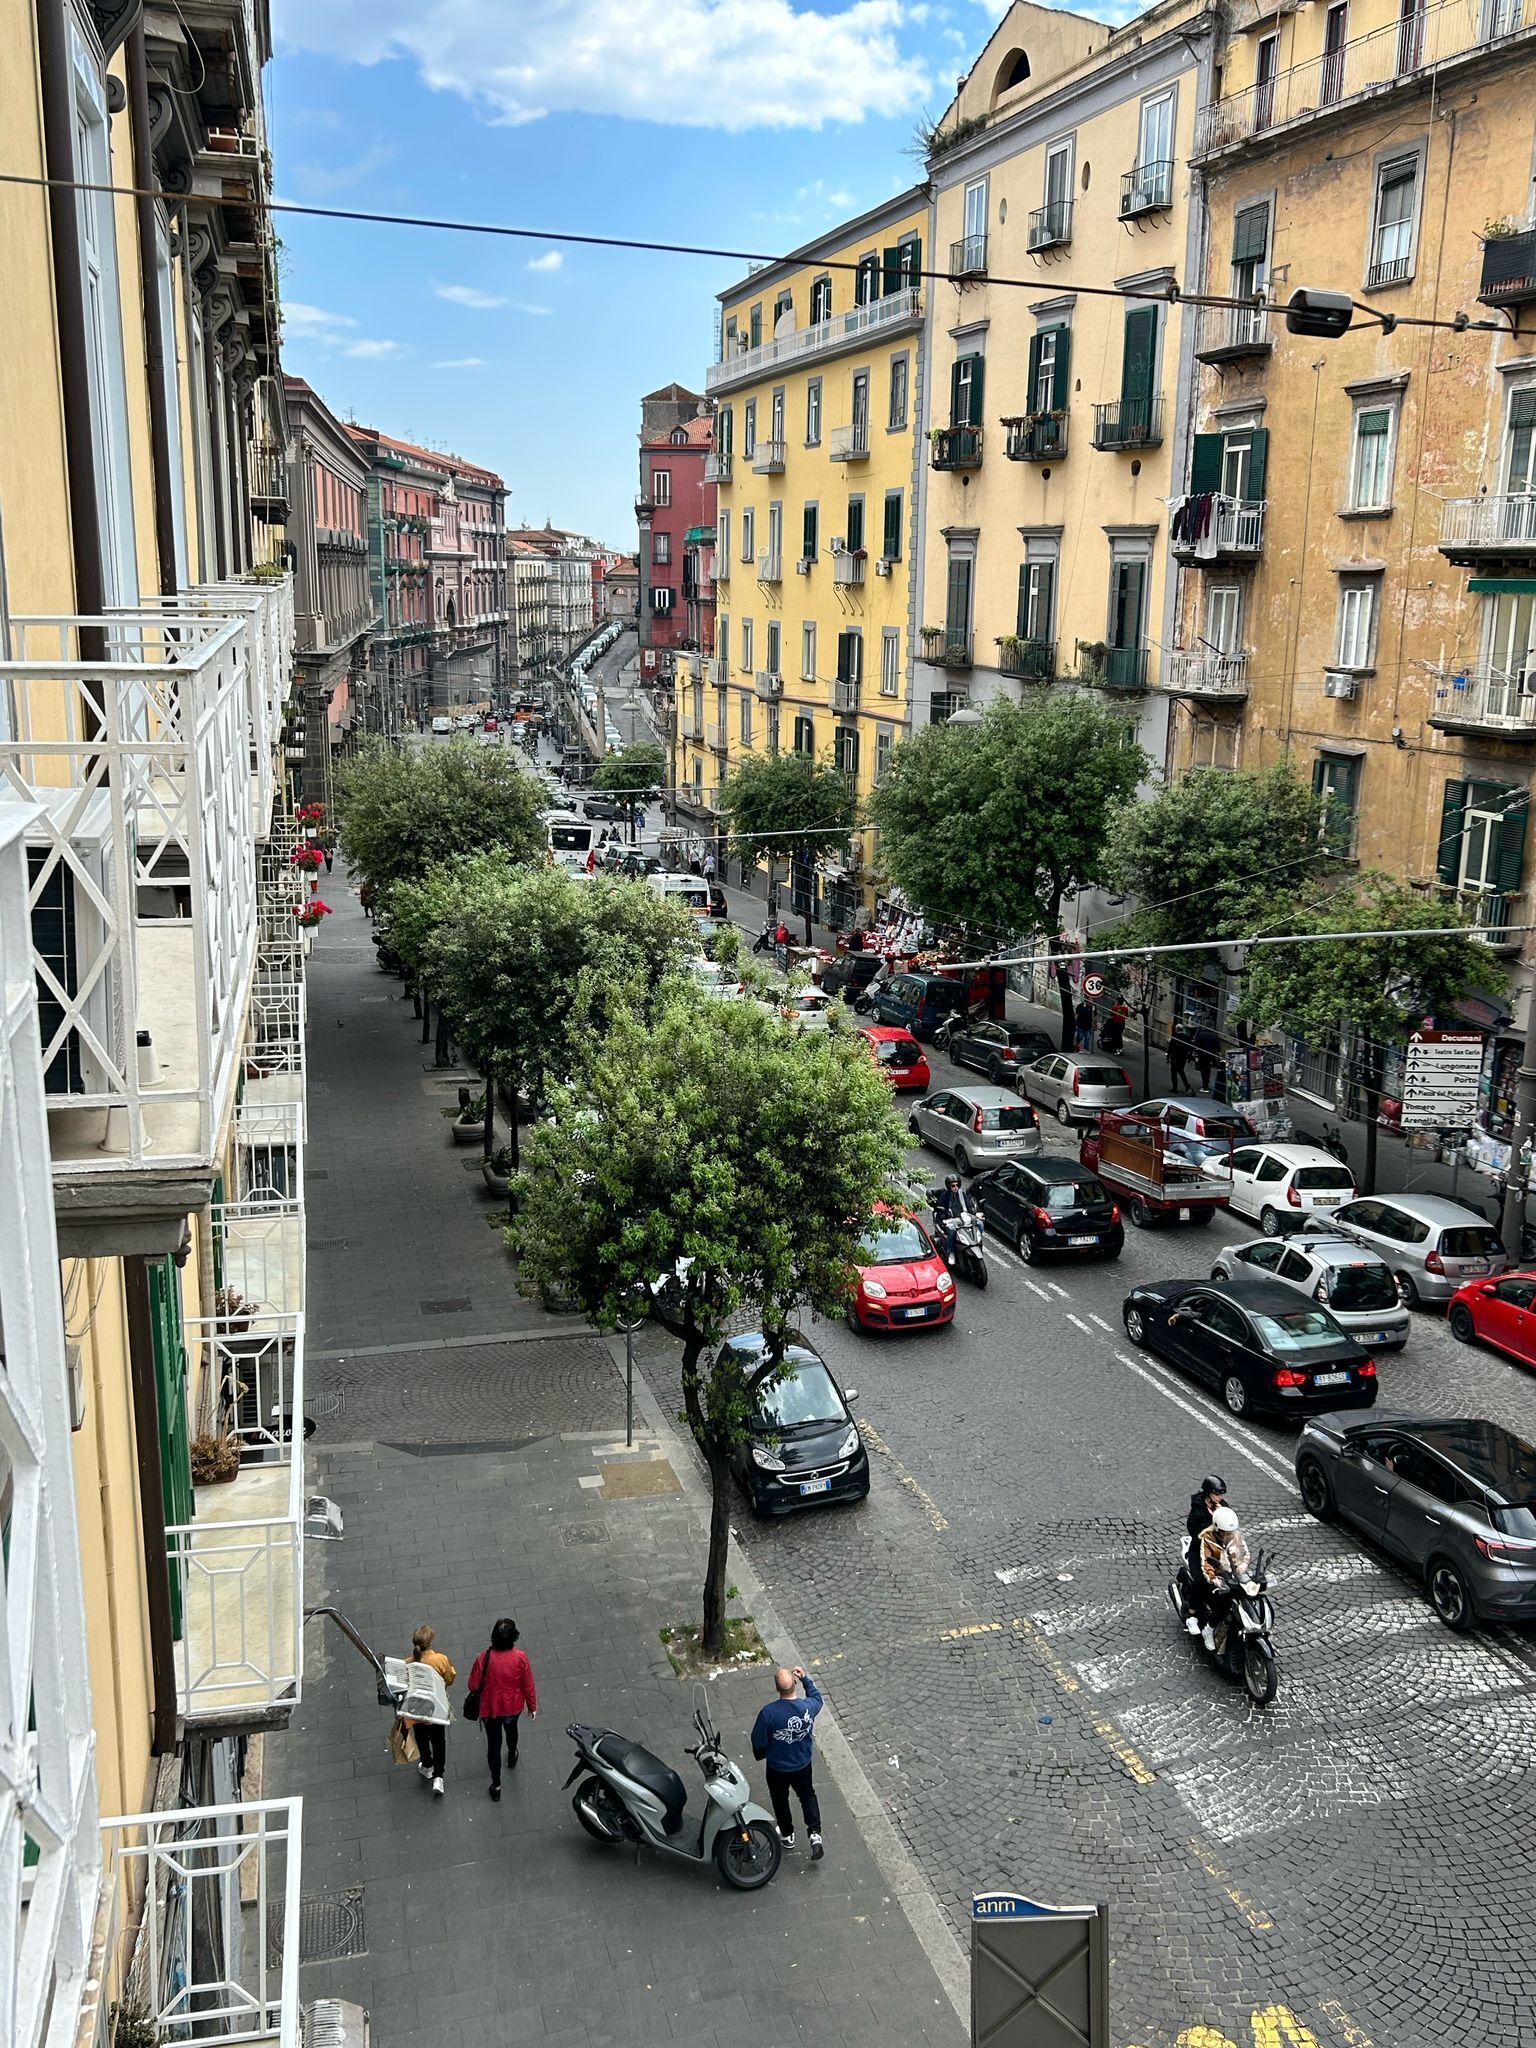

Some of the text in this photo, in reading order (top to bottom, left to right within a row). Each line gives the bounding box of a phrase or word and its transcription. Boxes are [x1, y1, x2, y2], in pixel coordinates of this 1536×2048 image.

[1441, 1034, 1482, 1042] Decumani
[1434, 1048, 1452, 1056] Teatro
[1436, 1063, 1479, 1071] Lungomare
[1405, 1103, 1436, 1111] Vomero
[976, 1900, 1016, 1913] anm
